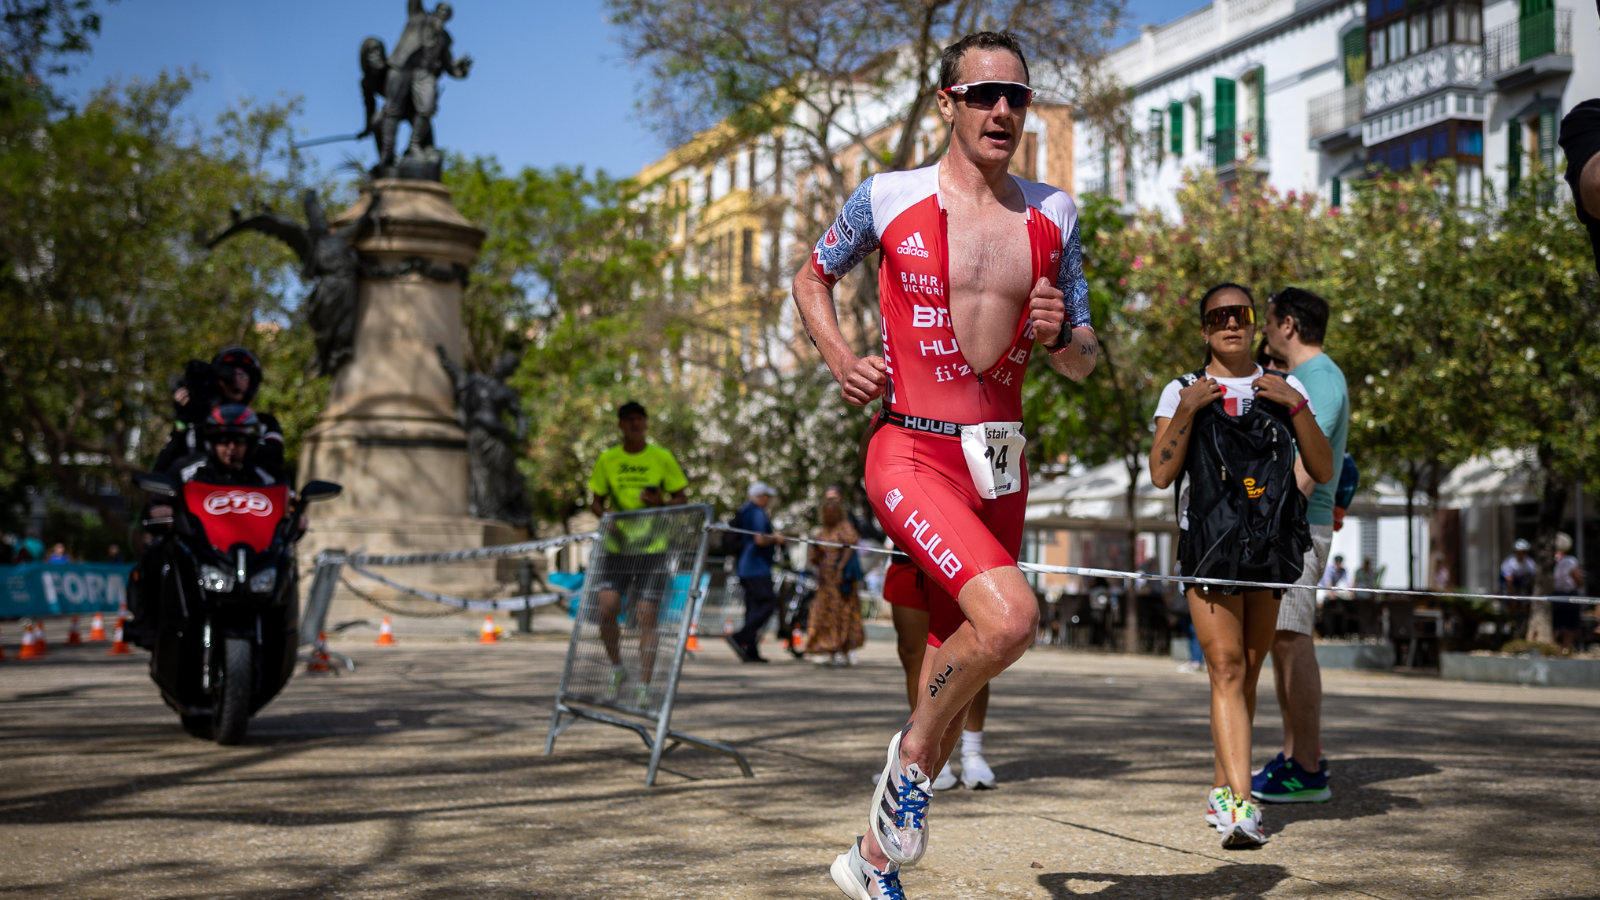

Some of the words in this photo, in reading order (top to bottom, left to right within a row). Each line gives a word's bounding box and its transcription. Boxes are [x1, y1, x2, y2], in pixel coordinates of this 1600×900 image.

[897, 246, 929, 258] adidas
[903, 283, 944, 296] VICTORI
[904, 415, 957, 435] HUUB
[903, 509, 963, 579] HUUB
